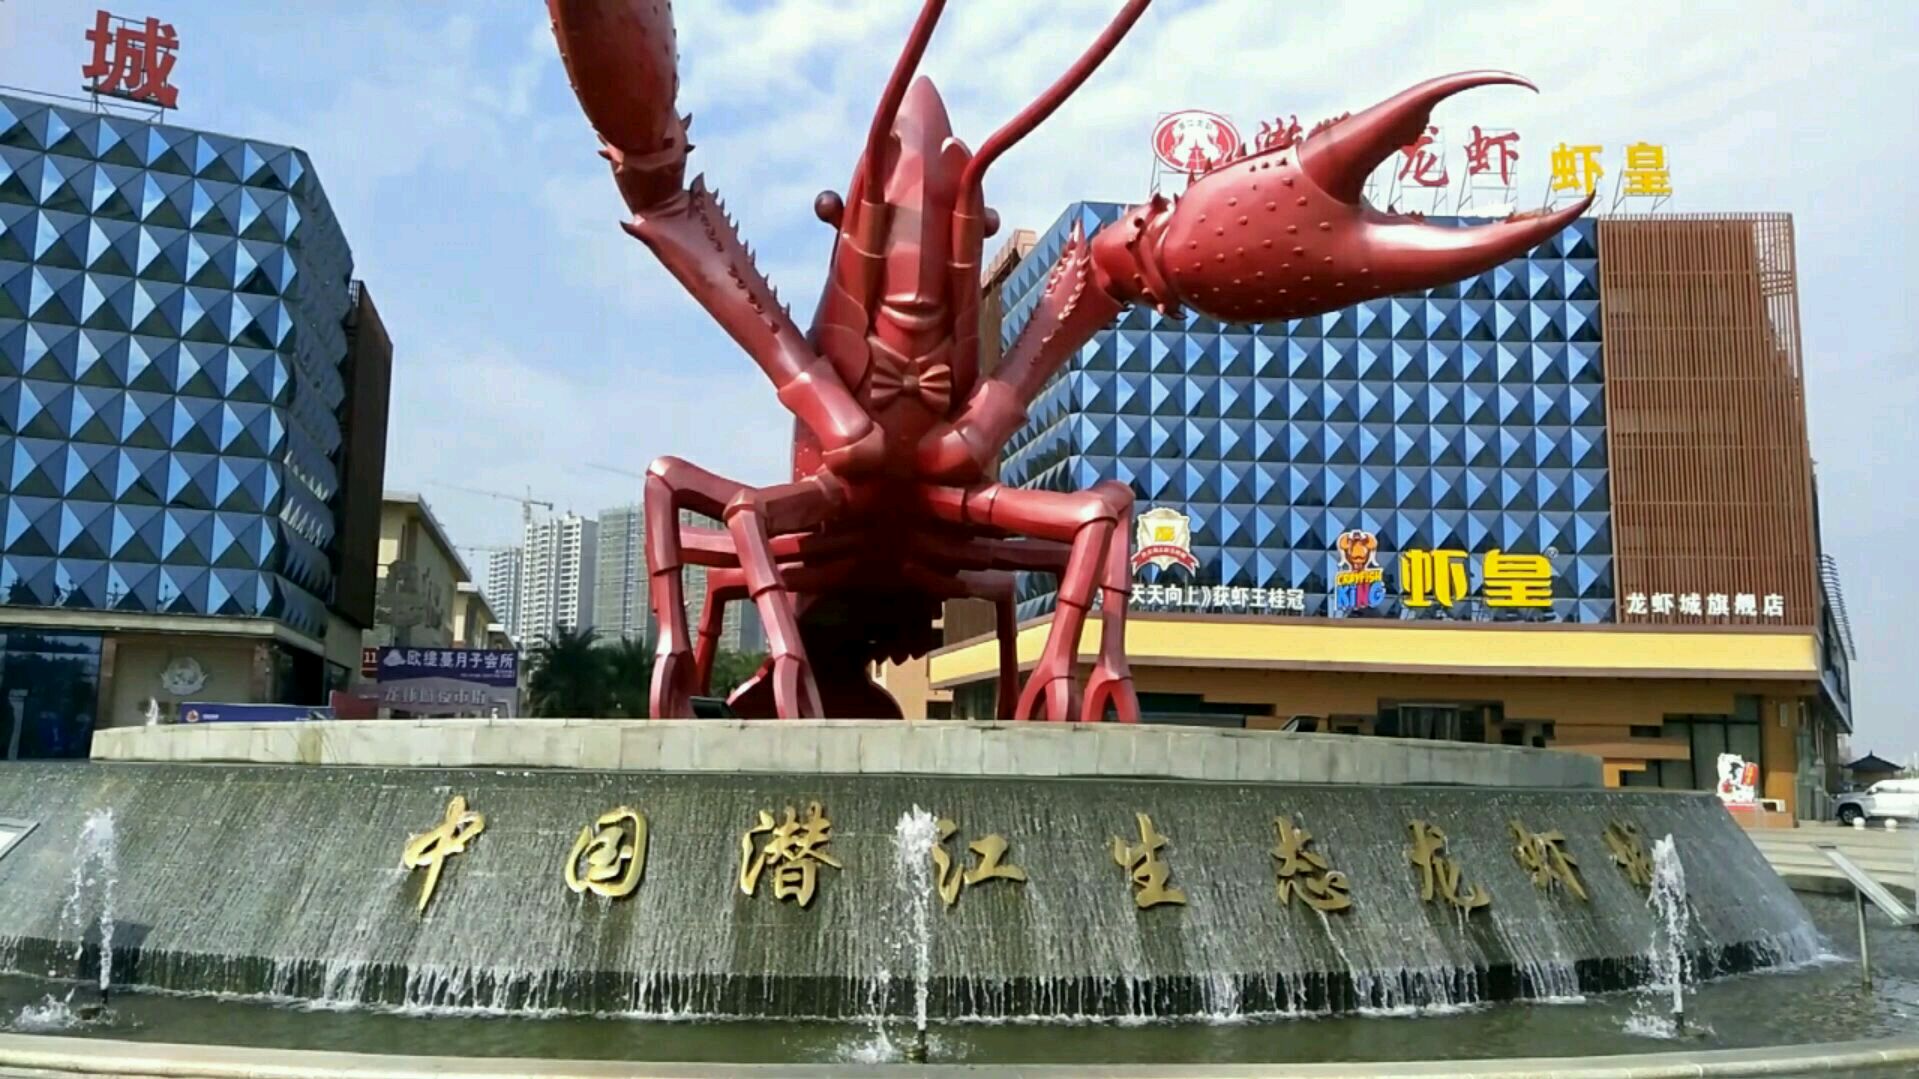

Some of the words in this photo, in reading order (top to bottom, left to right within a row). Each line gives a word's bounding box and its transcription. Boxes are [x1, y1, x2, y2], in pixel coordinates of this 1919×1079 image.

[82, 10, 179, 109] 城
[1551, 142, 1672, 196] 虾皇
[1400, 548, 1553, 609] 虾皇
[1626, 592, 1784, 617] 龙虾城旗舰店
